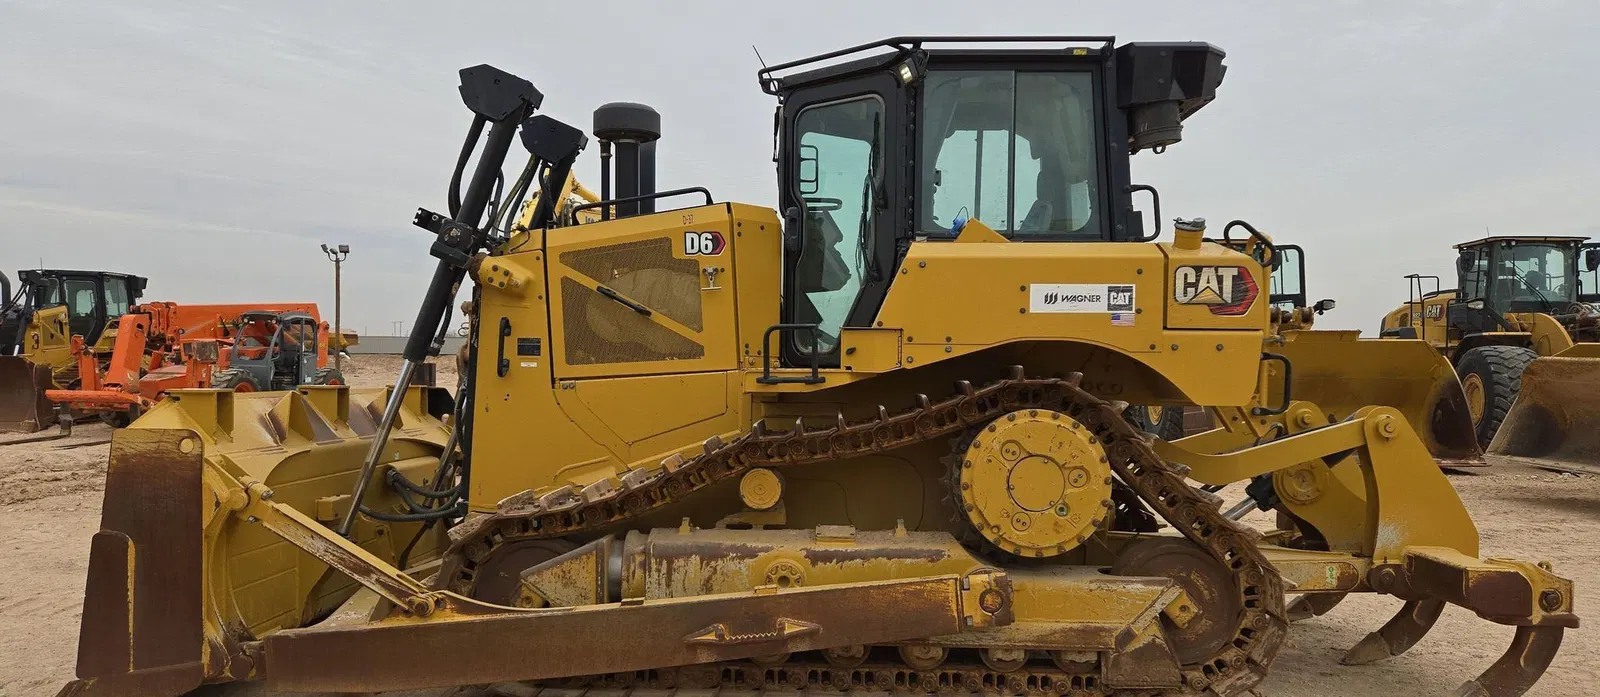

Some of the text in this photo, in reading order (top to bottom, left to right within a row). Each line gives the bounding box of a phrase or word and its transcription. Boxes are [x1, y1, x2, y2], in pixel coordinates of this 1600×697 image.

[685, 232, 713, 254] D6
[1175, 266, 1239, 304] CAT
[1061, 291, 1131, 305] WAGNER CAT
[1426, 304, 1442, 318] CAT
